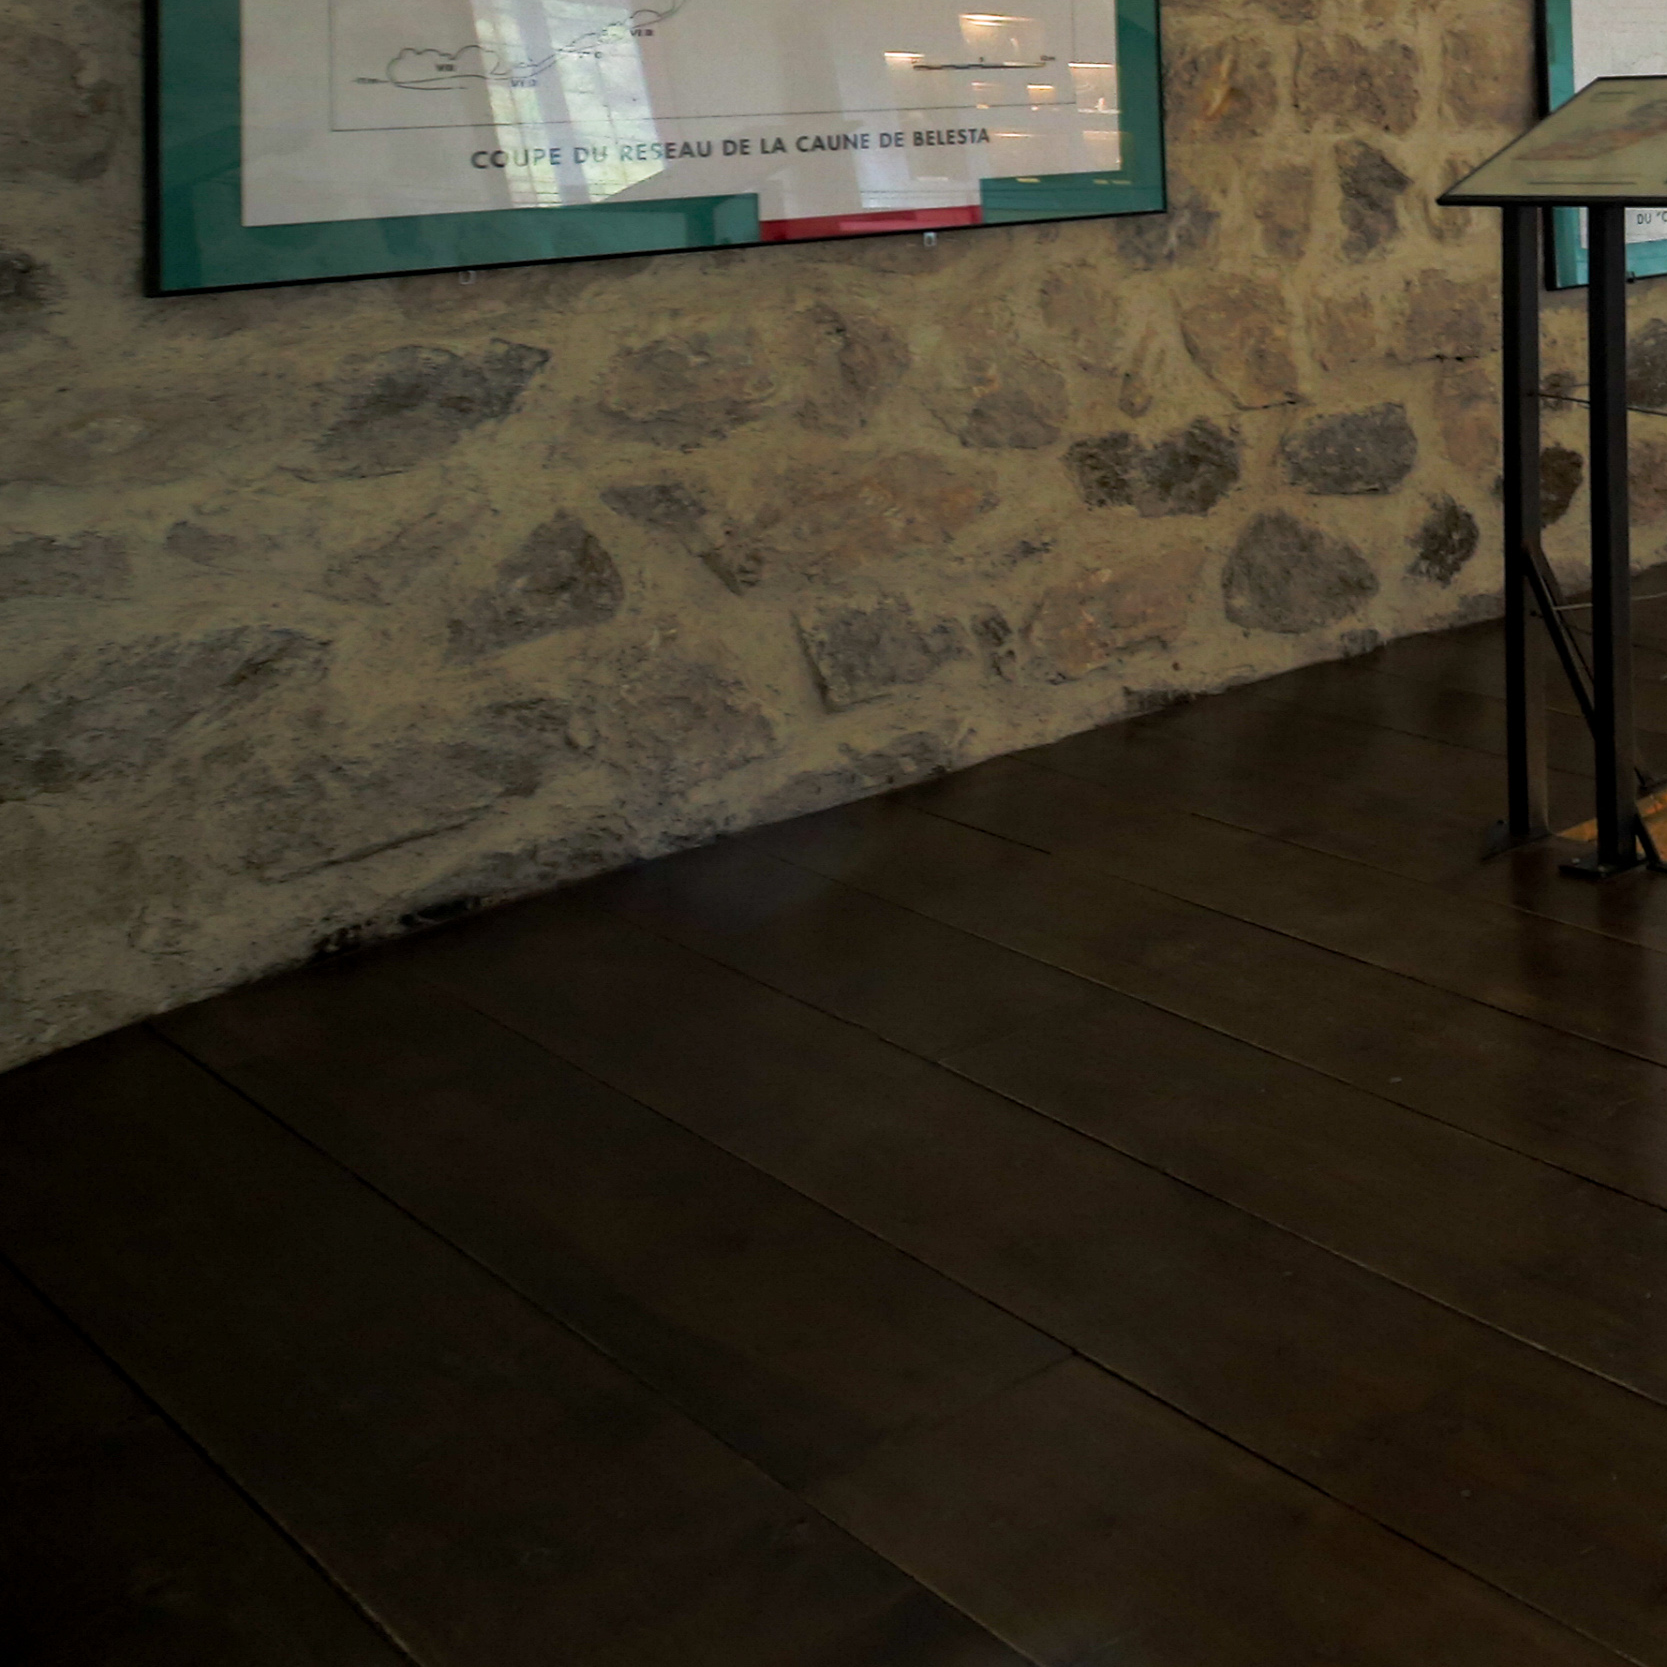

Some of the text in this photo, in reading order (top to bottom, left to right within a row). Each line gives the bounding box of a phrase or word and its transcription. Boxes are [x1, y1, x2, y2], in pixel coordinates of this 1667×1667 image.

[471, 127, 991, 169] COUPE DU RESEAU DE LA CAUNE DE BELESTA
[1637, 213, 1651, 225] DU
